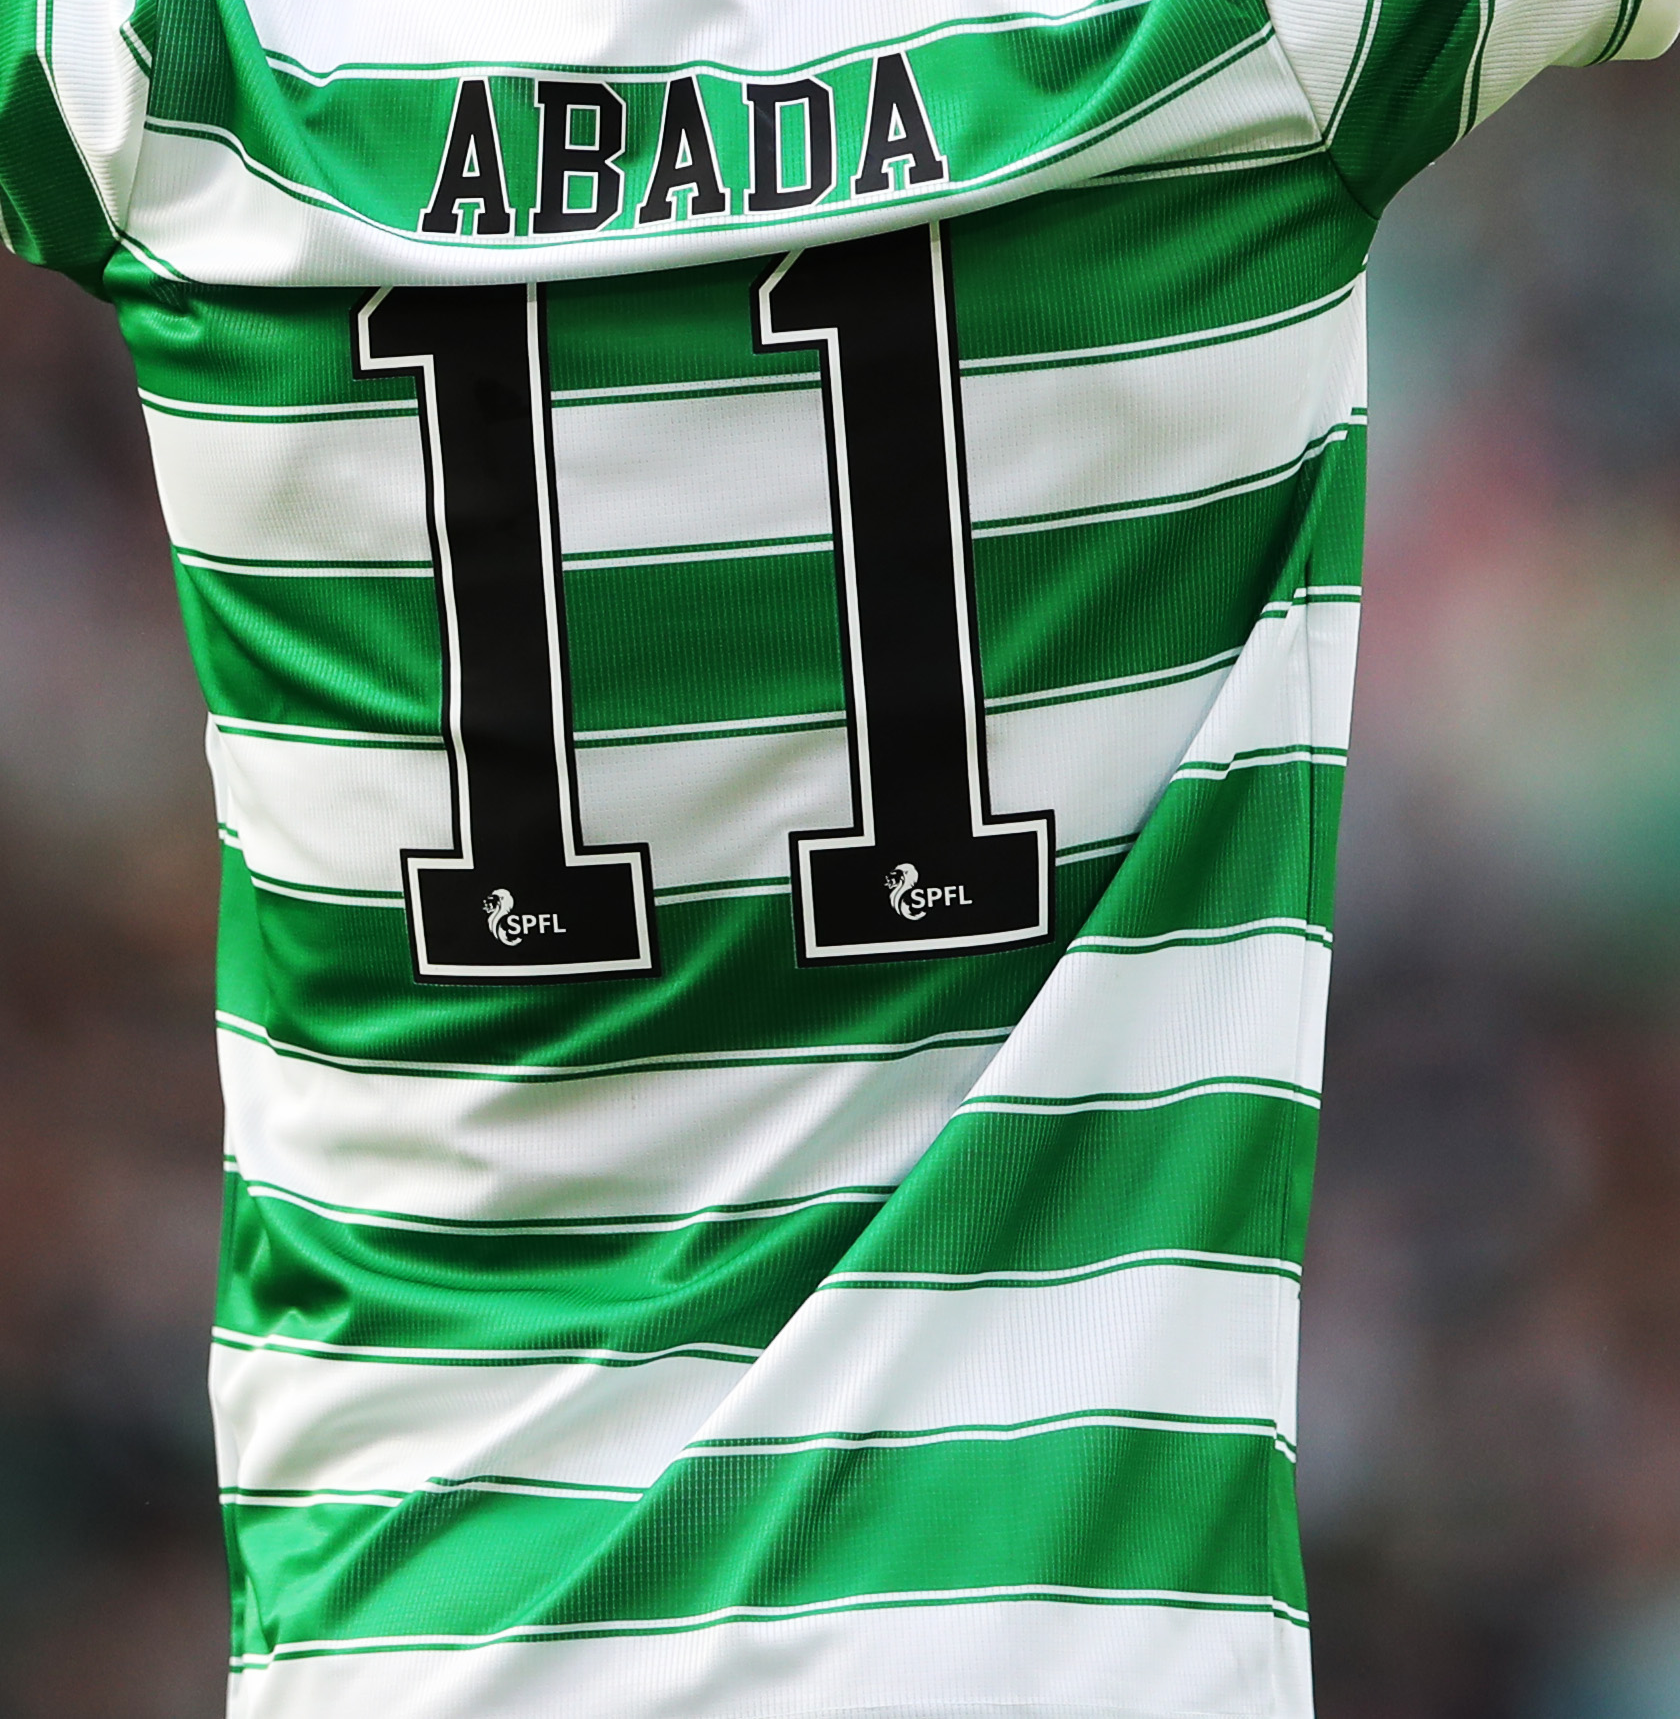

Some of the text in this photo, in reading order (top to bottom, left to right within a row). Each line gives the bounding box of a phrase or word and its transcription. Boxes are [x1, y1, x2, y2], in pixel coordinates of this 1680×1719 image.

[420, 53, 951, 235] ABADA
[350, 230, 1056, 984] 11
[506, 912, 567, 935] SPFL
[910, 885, 973, 909] SPFL
